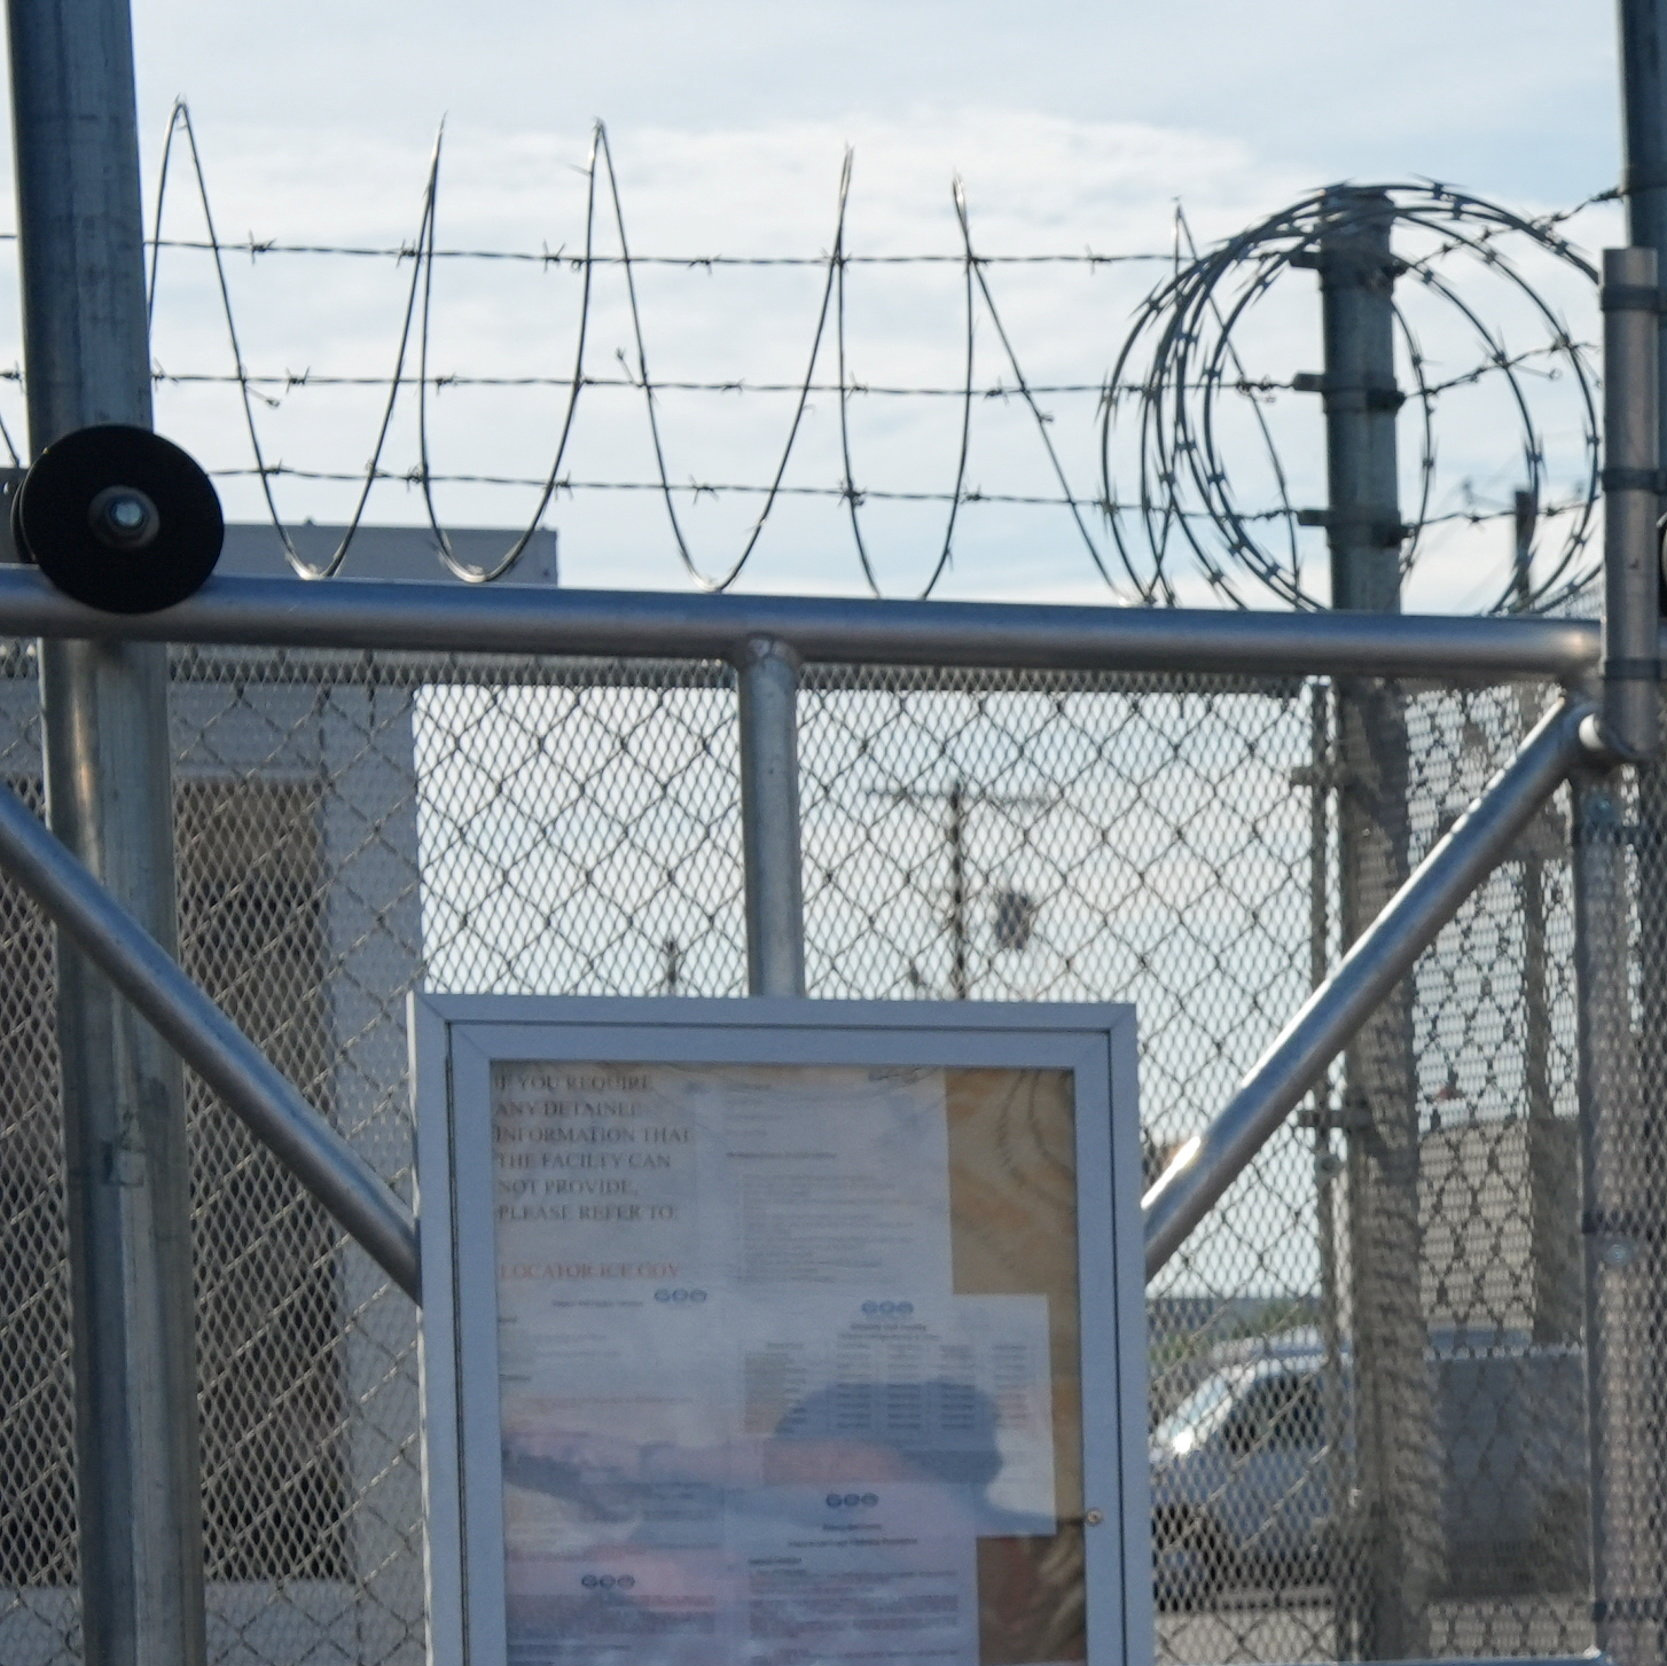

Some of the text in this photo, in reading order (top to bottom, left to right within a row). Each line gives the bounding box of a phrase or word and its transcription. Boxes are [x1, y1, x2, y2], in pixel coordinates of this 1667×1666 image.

[494, 1074, 651, 1091] IF YOU REQUIRE
[495, 1101, 536, 1117] ANY
[494, 1127, 693, 1143] INFORMATION THAT
[497, 1153, 534, 1169] THE
[628, 1153, 671, 1169] CAN
[499, 1179, 538, 1196] NOT
[499, 1205, 569, 1221] PLEASE
[578, 1205, 643, 1221] REFER
